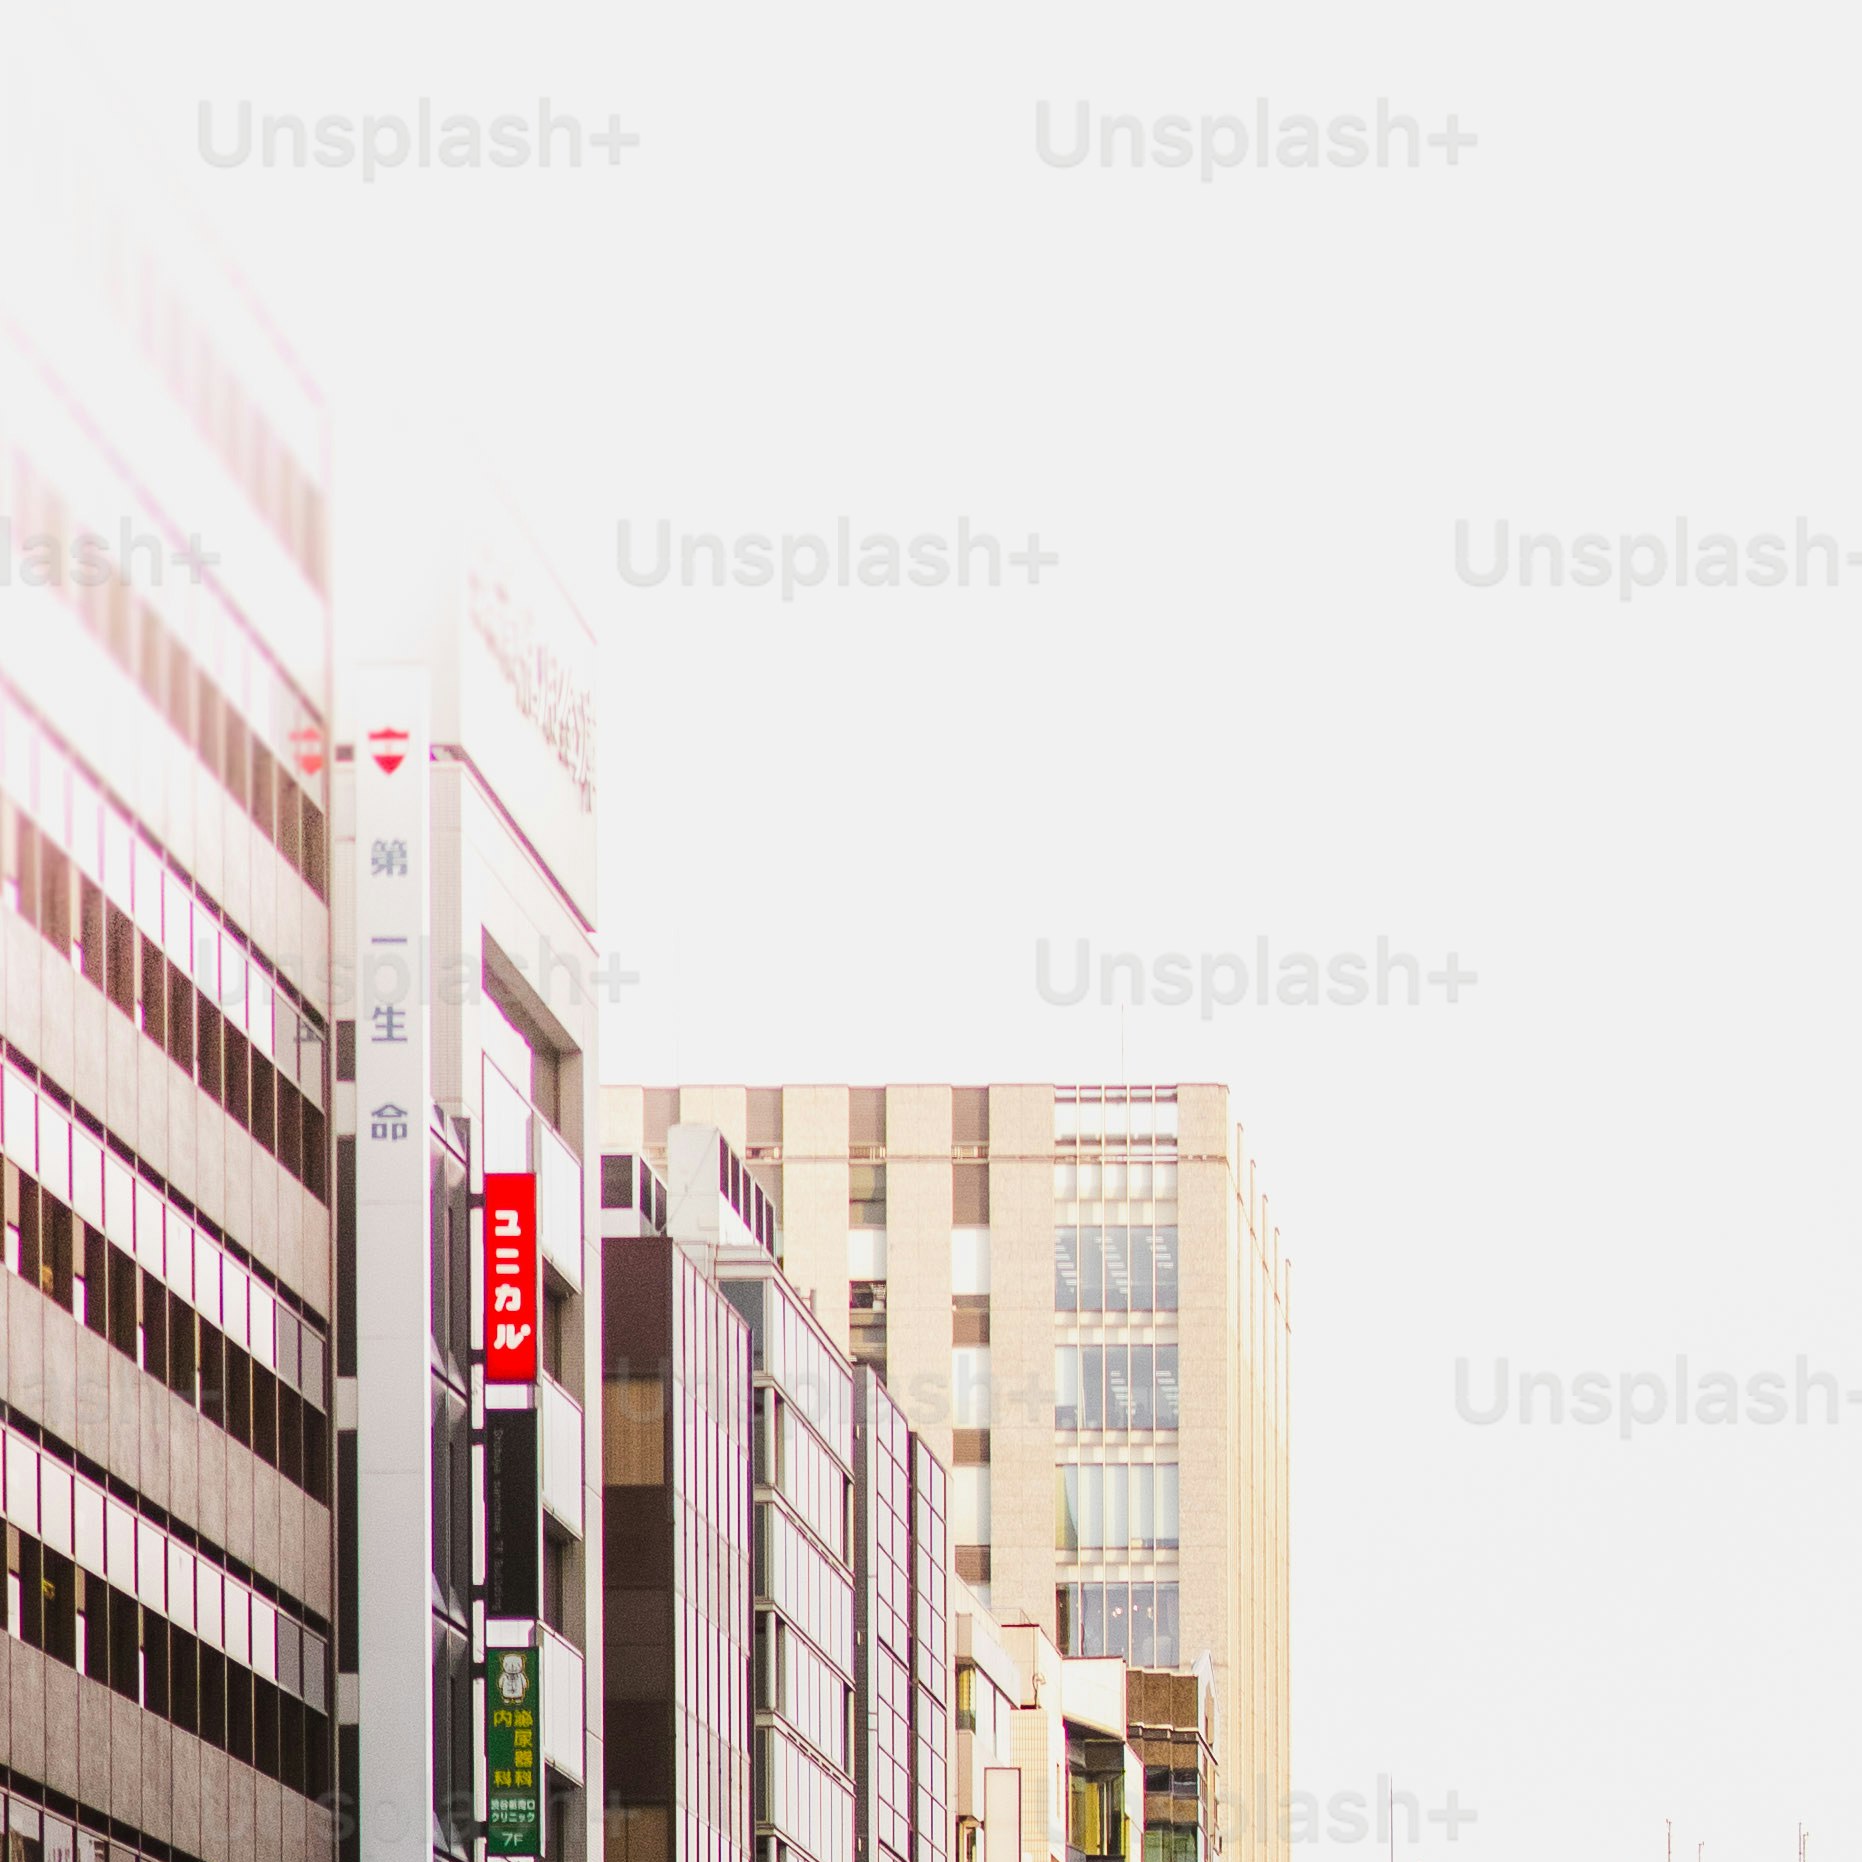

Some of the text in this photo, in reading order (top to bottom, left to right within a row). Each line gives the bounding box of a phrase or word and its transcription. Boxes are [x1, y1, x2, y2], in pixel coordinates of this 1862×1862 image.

[370, 838, 409, 1143] 第一生命
[494, 1208, 531, 1351] ユニカル
[502, 1833, 524, 1847] 7F
